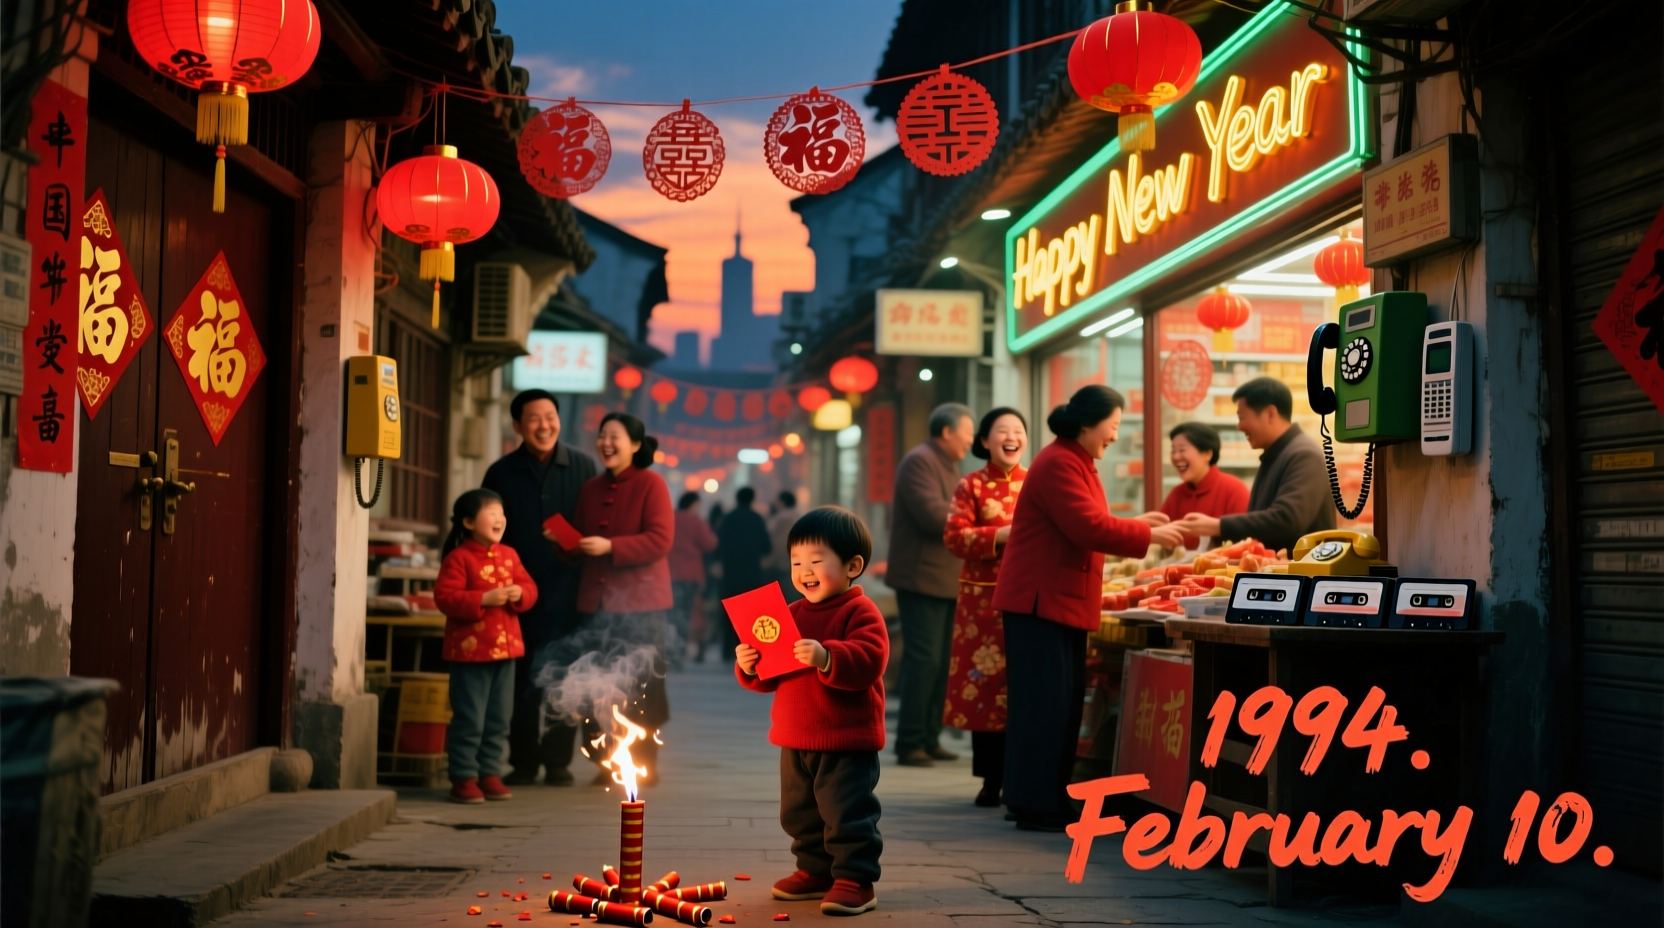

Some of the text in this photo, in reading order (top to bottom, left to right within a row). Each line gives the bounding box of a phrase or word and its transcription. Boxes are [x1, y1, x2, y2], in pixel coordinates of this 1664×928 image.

[532, 111, 597, 181] 福
[778, 103, 850, 173] 福
[1013, 214, 1102, 317] Happy
[1105, 153, 1197, 256] New
[1196, 63, 1328, 203] Year
[78, 236, 129, 364] 福
[187, 289, 247, 398] 福
